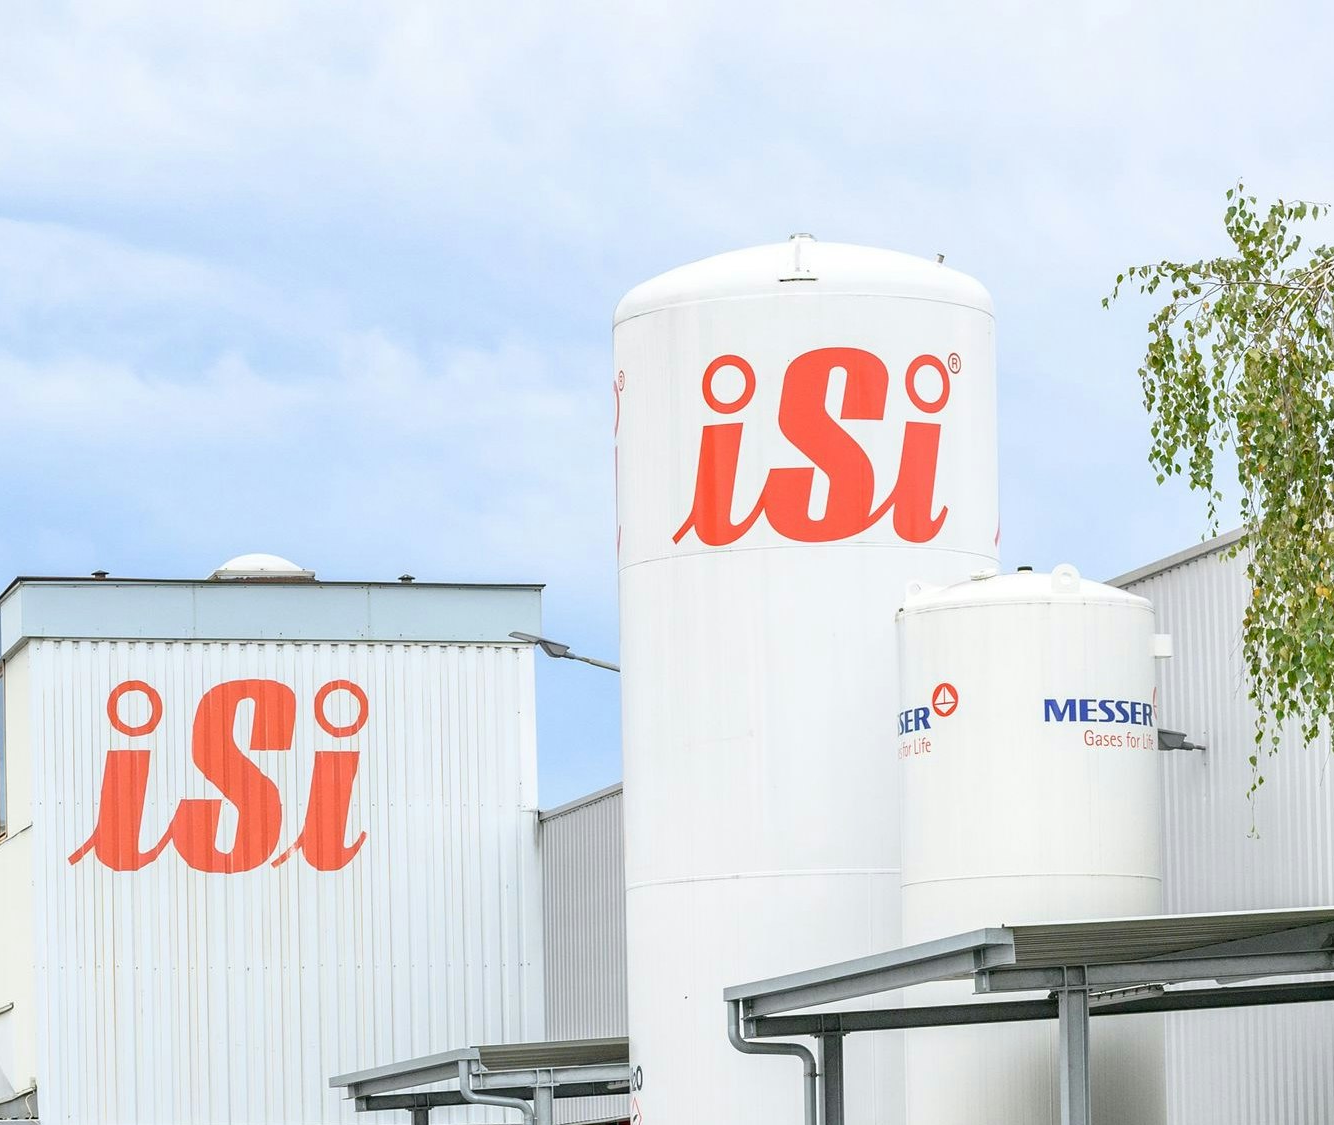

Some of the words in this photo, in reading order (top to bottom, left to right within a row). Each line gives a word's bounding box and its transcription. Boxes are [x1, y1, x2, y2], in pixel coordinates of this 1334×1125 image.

[1044, 698, 1153, 727] MESSER
[914, 737, 931, 754] Life
[1084, 729, 1123, 747] Gases
[1126, 731, 1141, 749] for
[67, 678, 369, 874] iSi
